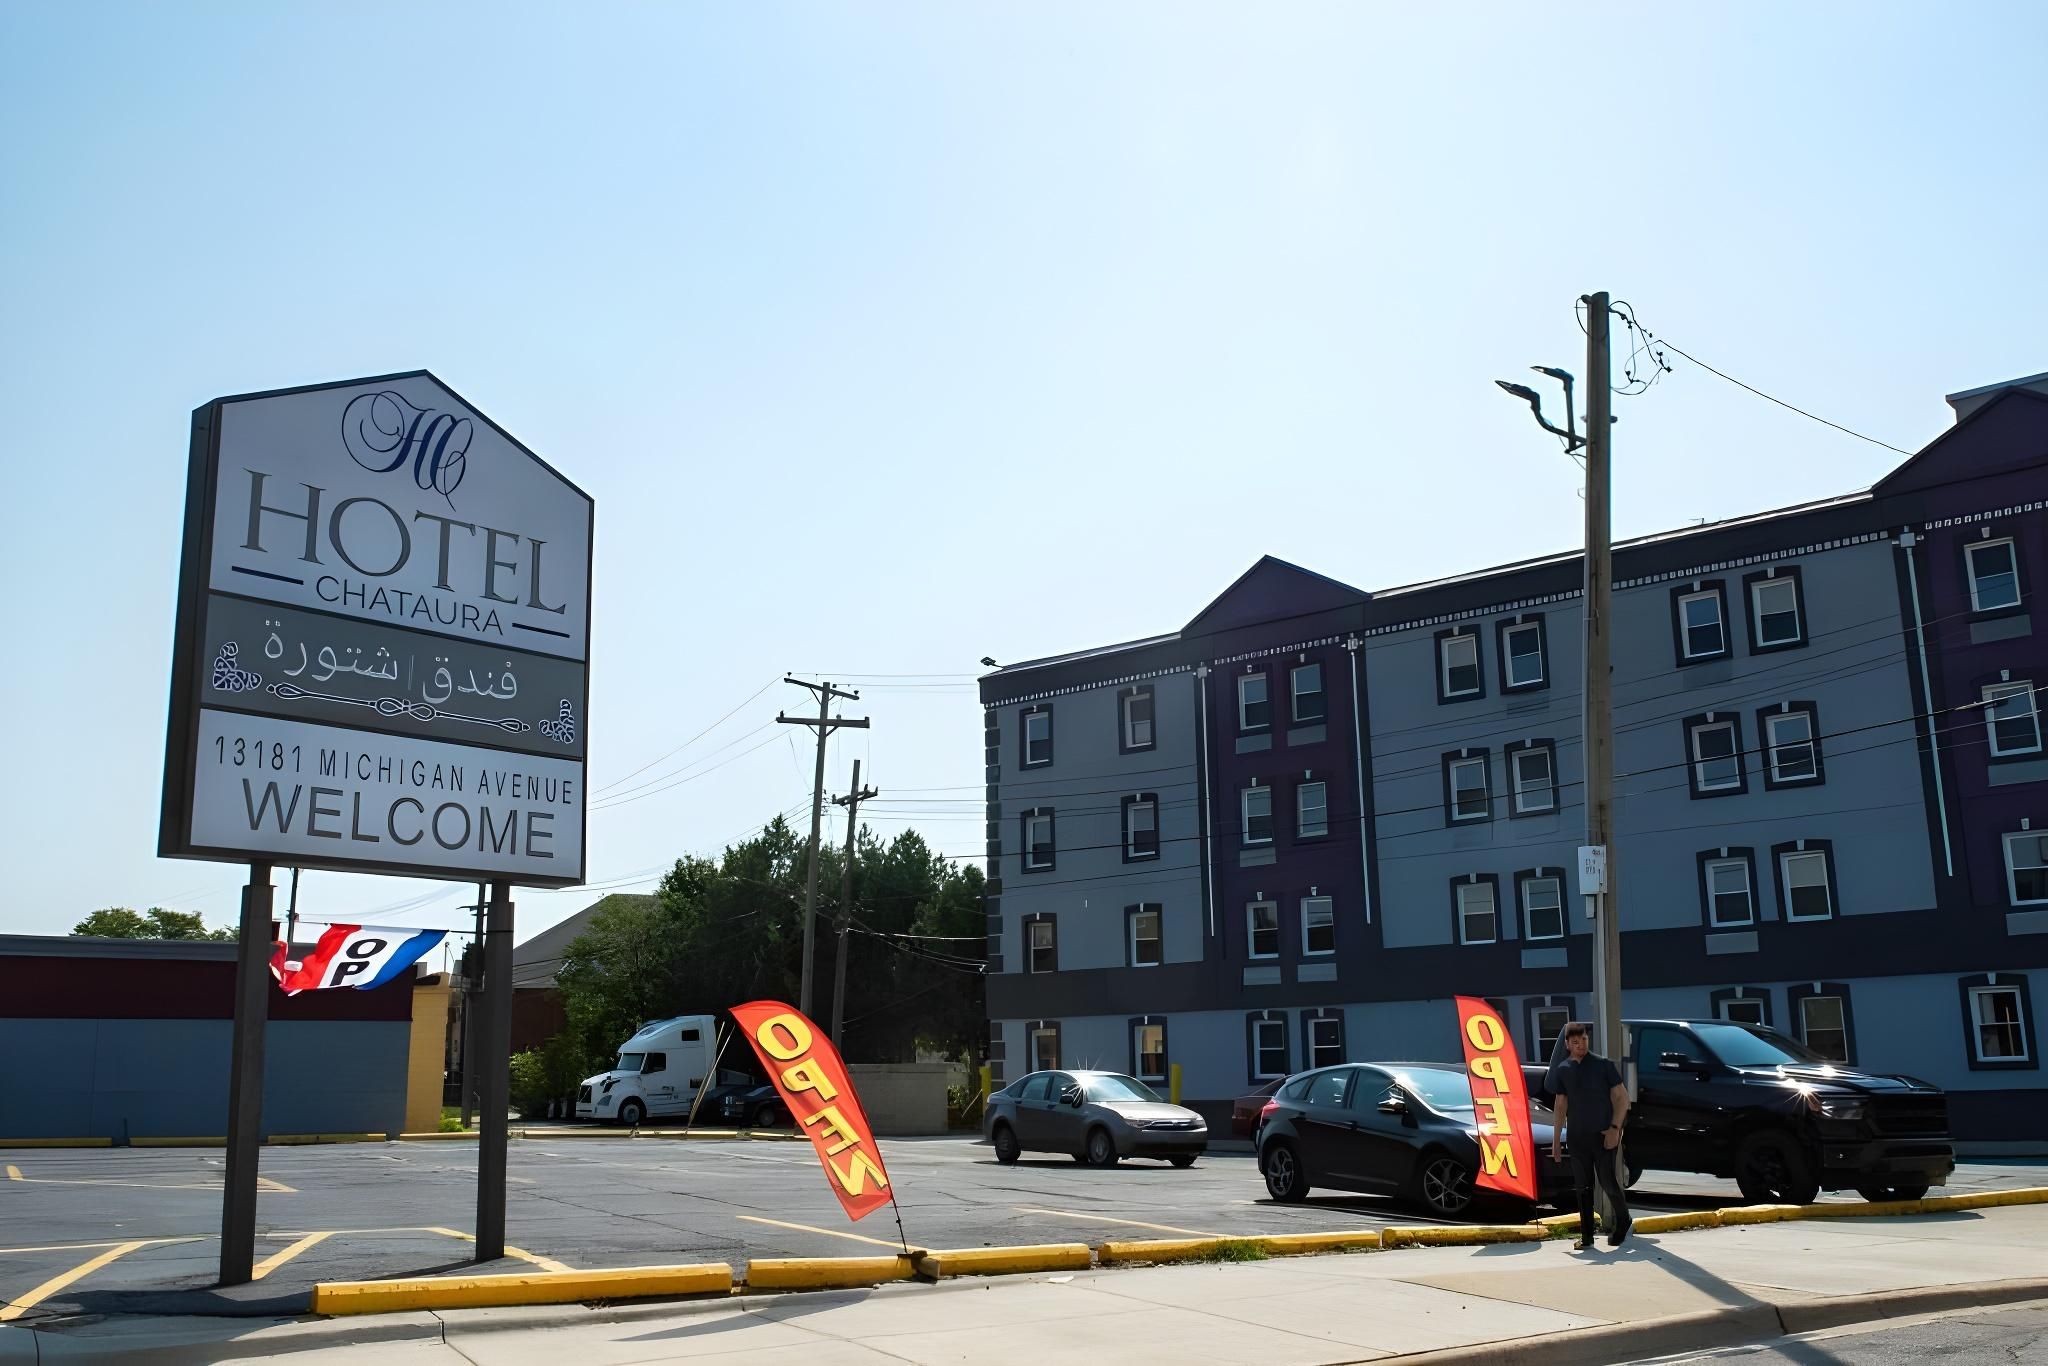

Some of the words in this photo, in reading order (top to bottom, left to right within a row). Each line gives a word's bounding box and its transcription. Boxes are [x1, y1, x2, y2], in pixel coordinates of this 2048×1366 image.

[241, 467, 567, 615] HOTEL
[316, 575, 504, 637] CHATAURA
[264, 619, 398, 682] شتورة
[422, 655, 518, 704] فندق
[215, 735, 302, 774] 13181
[319, 748, 464, 792] MICHIGAN
[478, 769, 573, 805] AVENUE
[242, 777, 555, 859] WELCOME
